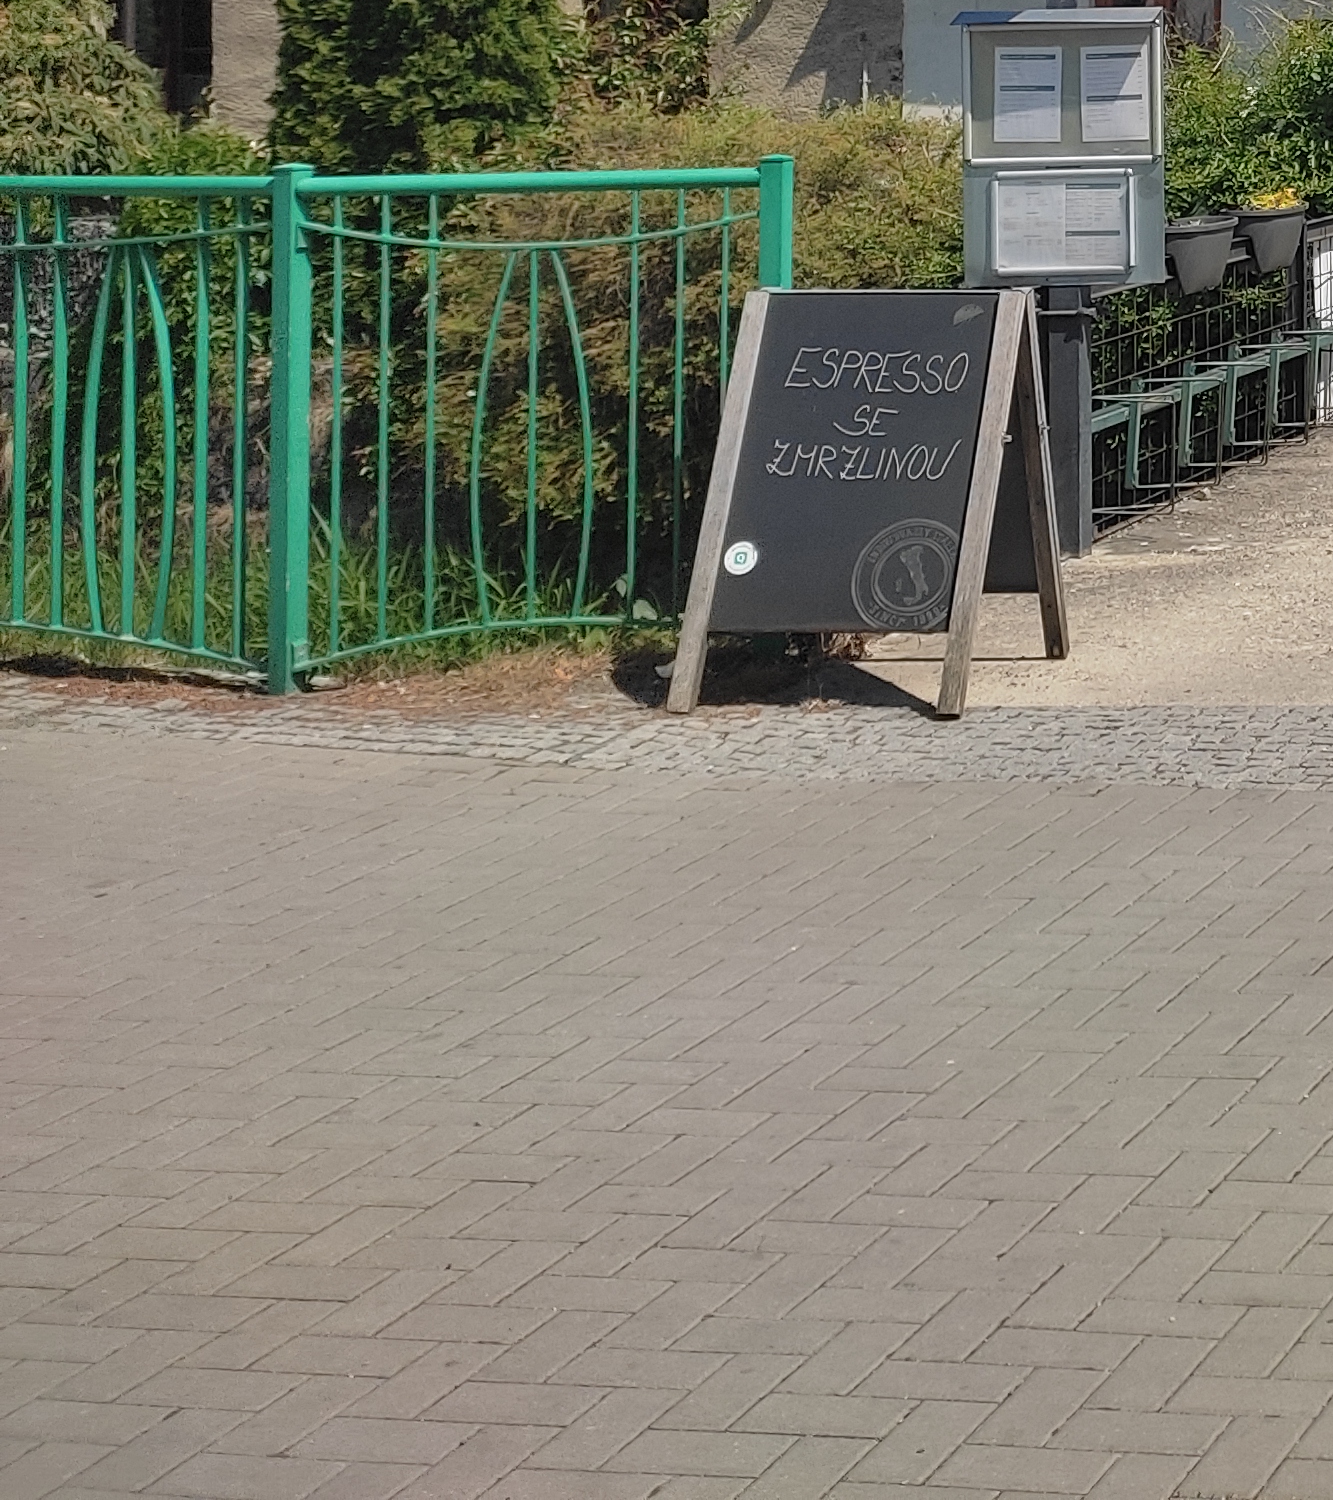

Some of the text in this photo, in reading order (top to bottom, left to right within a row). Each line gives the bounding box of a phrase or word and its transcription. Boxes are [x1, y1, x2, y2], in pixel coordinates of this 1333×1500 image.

[784, 347, 970, 395] ESPRESSO
[833, 404, 899, 436] SE
[765, 438, 963, 481] ZMRZLINOU
